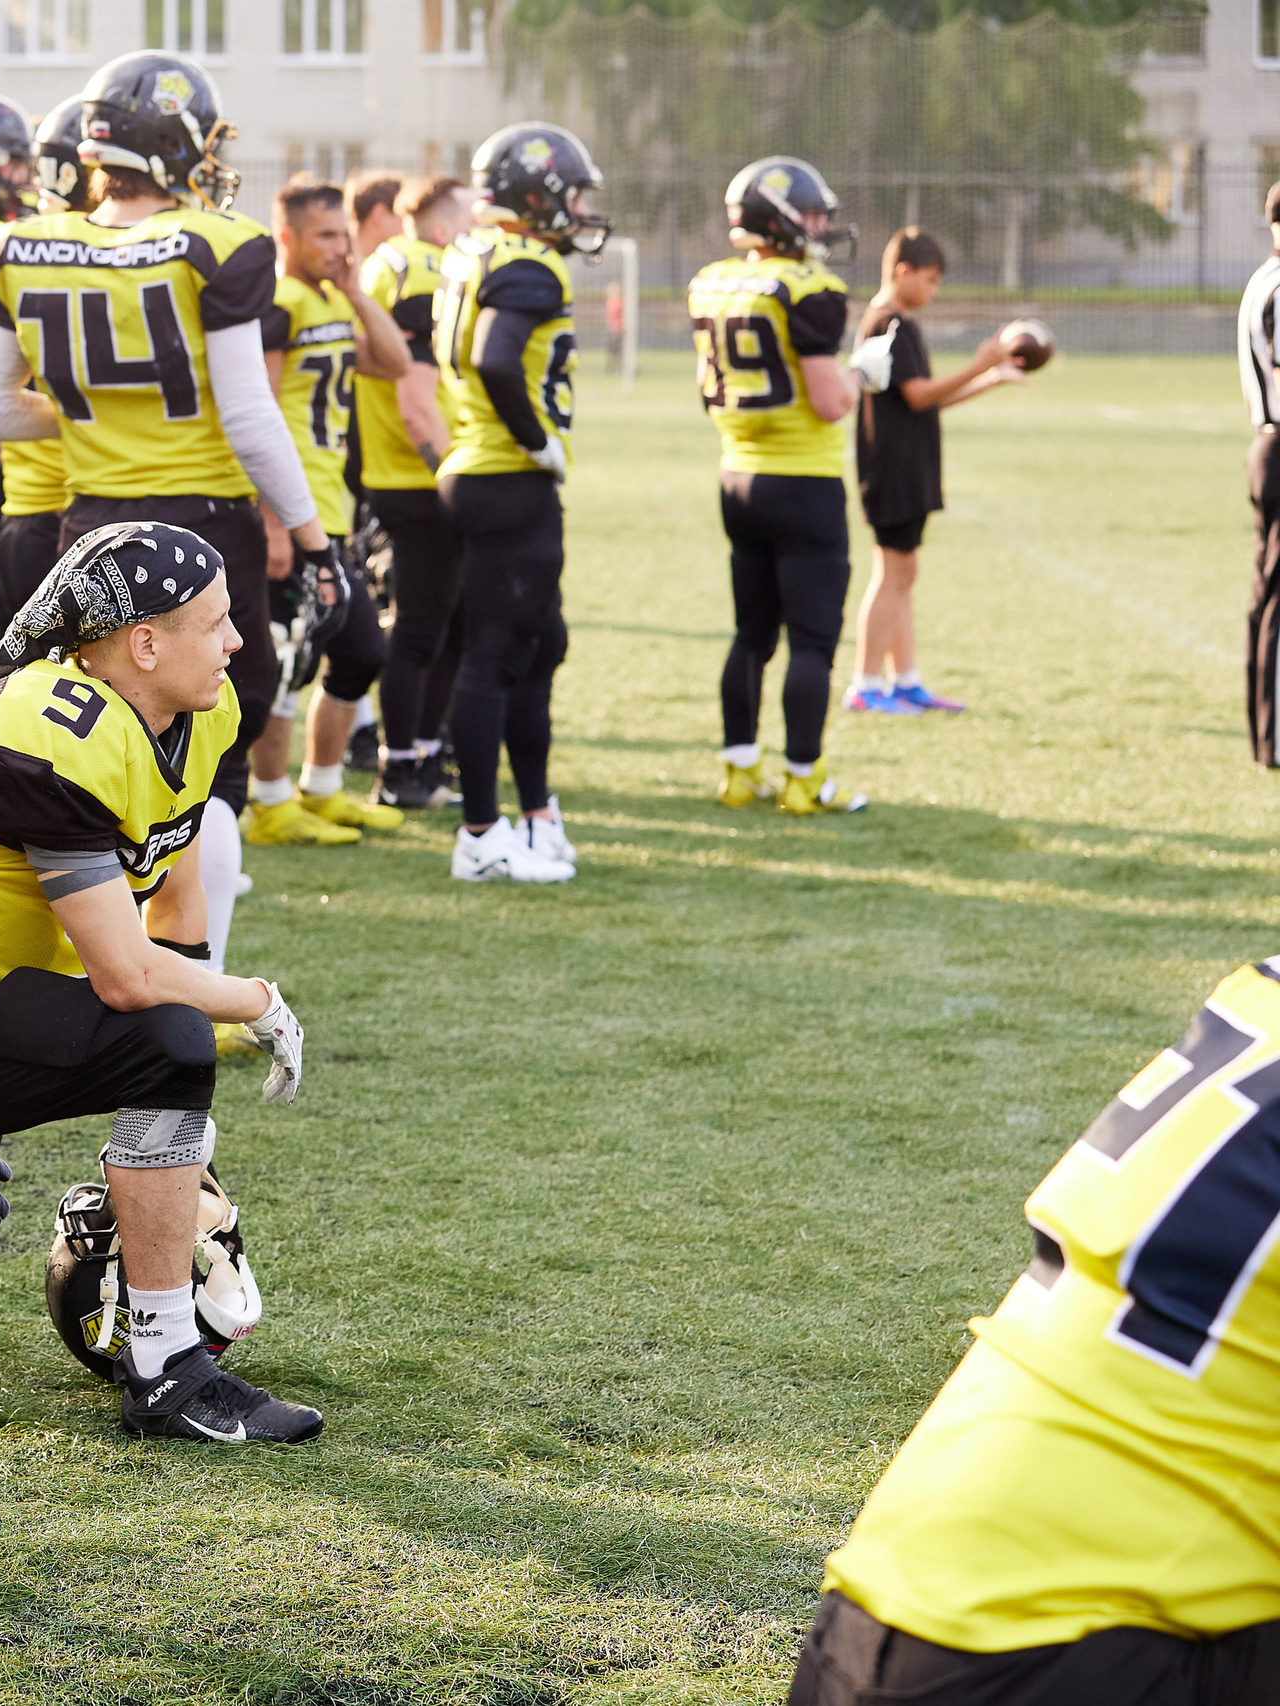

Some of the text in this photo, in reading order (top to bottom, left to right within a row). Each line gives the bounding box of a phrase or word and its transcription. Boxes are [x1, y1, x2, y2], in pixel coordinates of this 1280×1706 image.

[16, 279, 202, 424] 14
[41, 677, 108, 741] 9
[132, 1328, 163, 1338] didas
[147, 1379, 179, 1408] ALPHA
